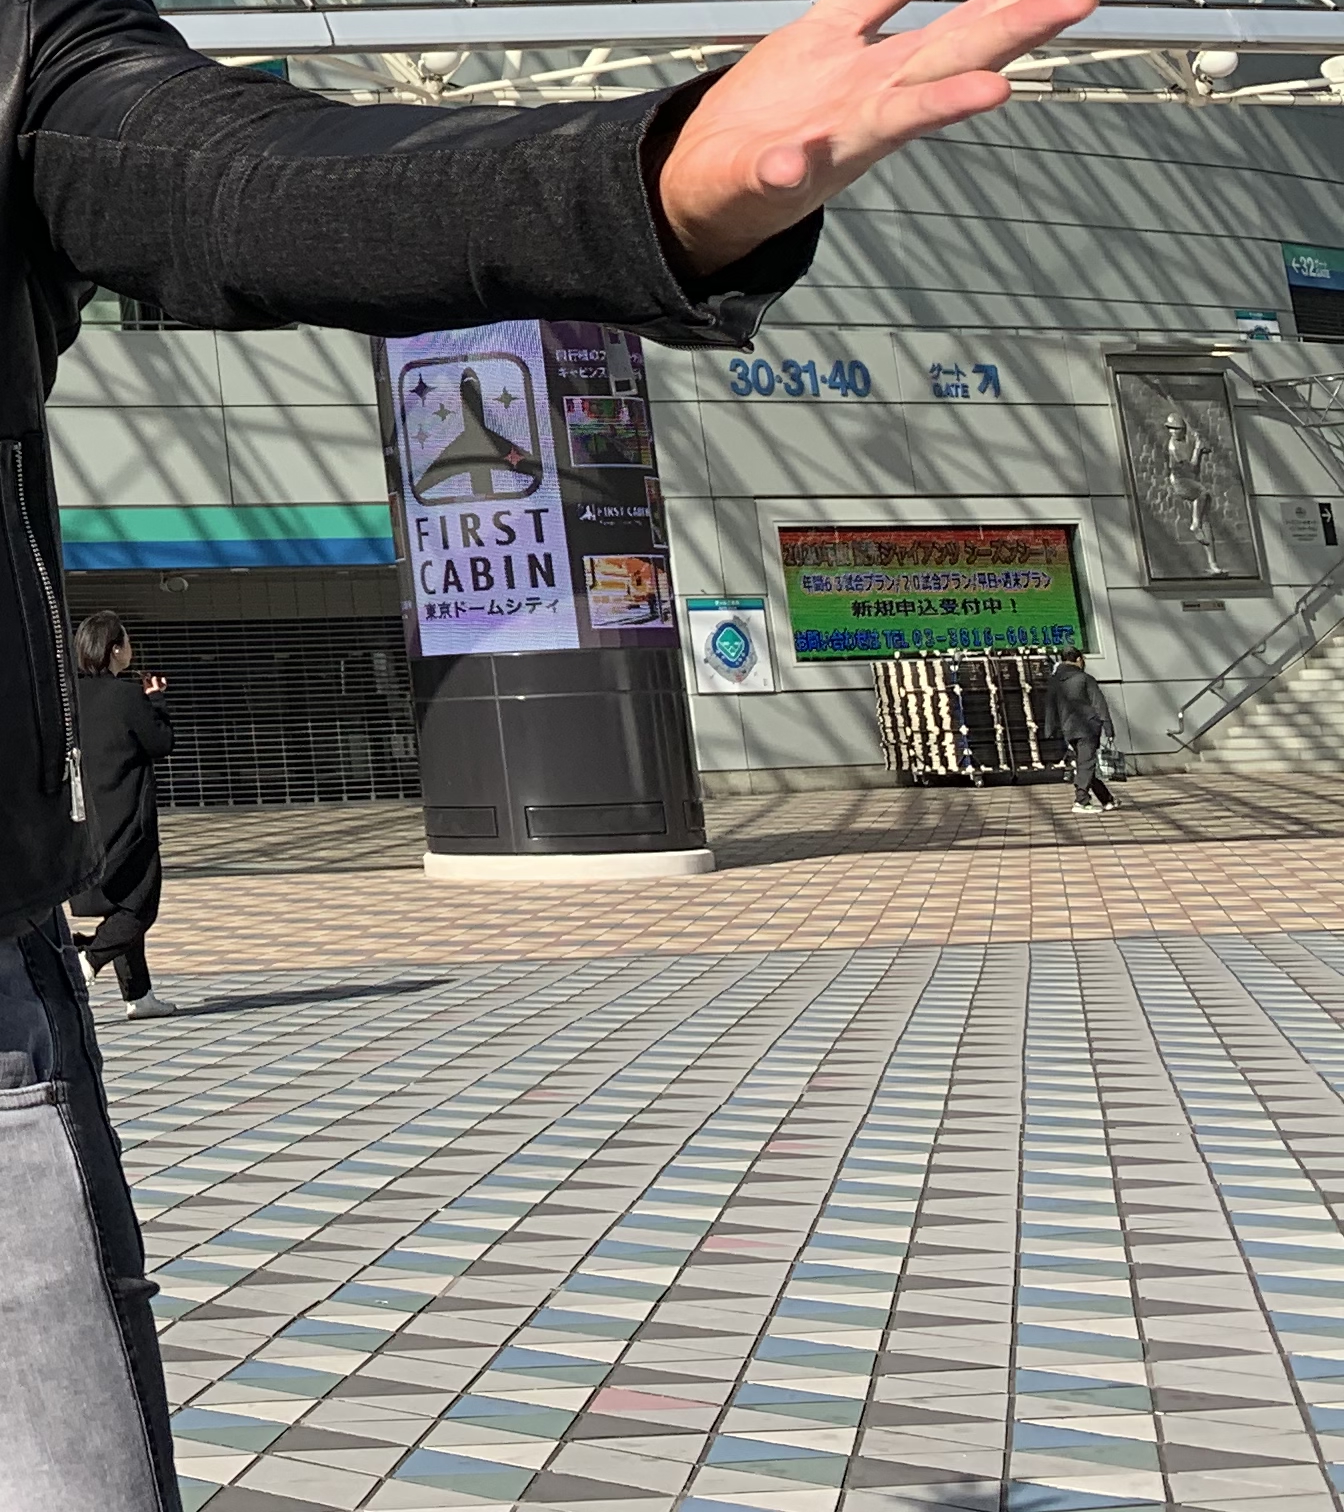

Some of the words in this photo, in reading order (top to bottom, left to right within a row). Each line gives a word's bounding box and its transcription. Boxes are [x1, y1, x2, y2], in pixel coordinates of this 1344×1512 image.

[1299, 256, 1316, 277] 32
[928, 362, 967, 382] ゲート
[932, 382, 970, 399] GATE
[415, 508, 550, 552] FIRST
[420, 552, 556, 595] CABIN
[425, 596, 559, 621] 東京ドームシティ
